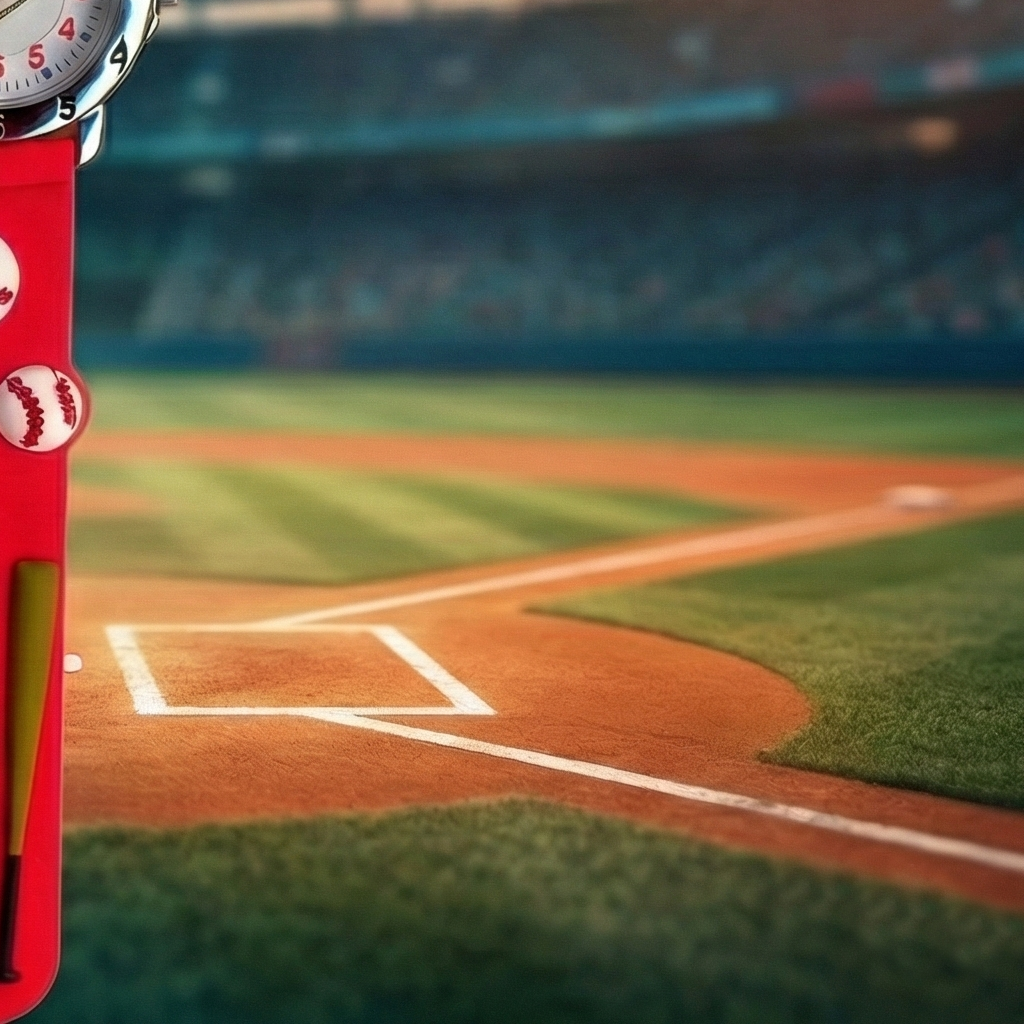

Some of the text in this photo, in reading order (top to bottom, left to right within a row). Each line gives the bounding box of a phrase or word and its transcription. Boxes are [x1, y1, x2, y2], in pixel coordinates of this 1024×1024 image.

[58, 18, 75, 40] 4
[28, 44, 44, 69] 5
[110, 34, 127, 76] 4
[59, 96, 76, 119] 5
